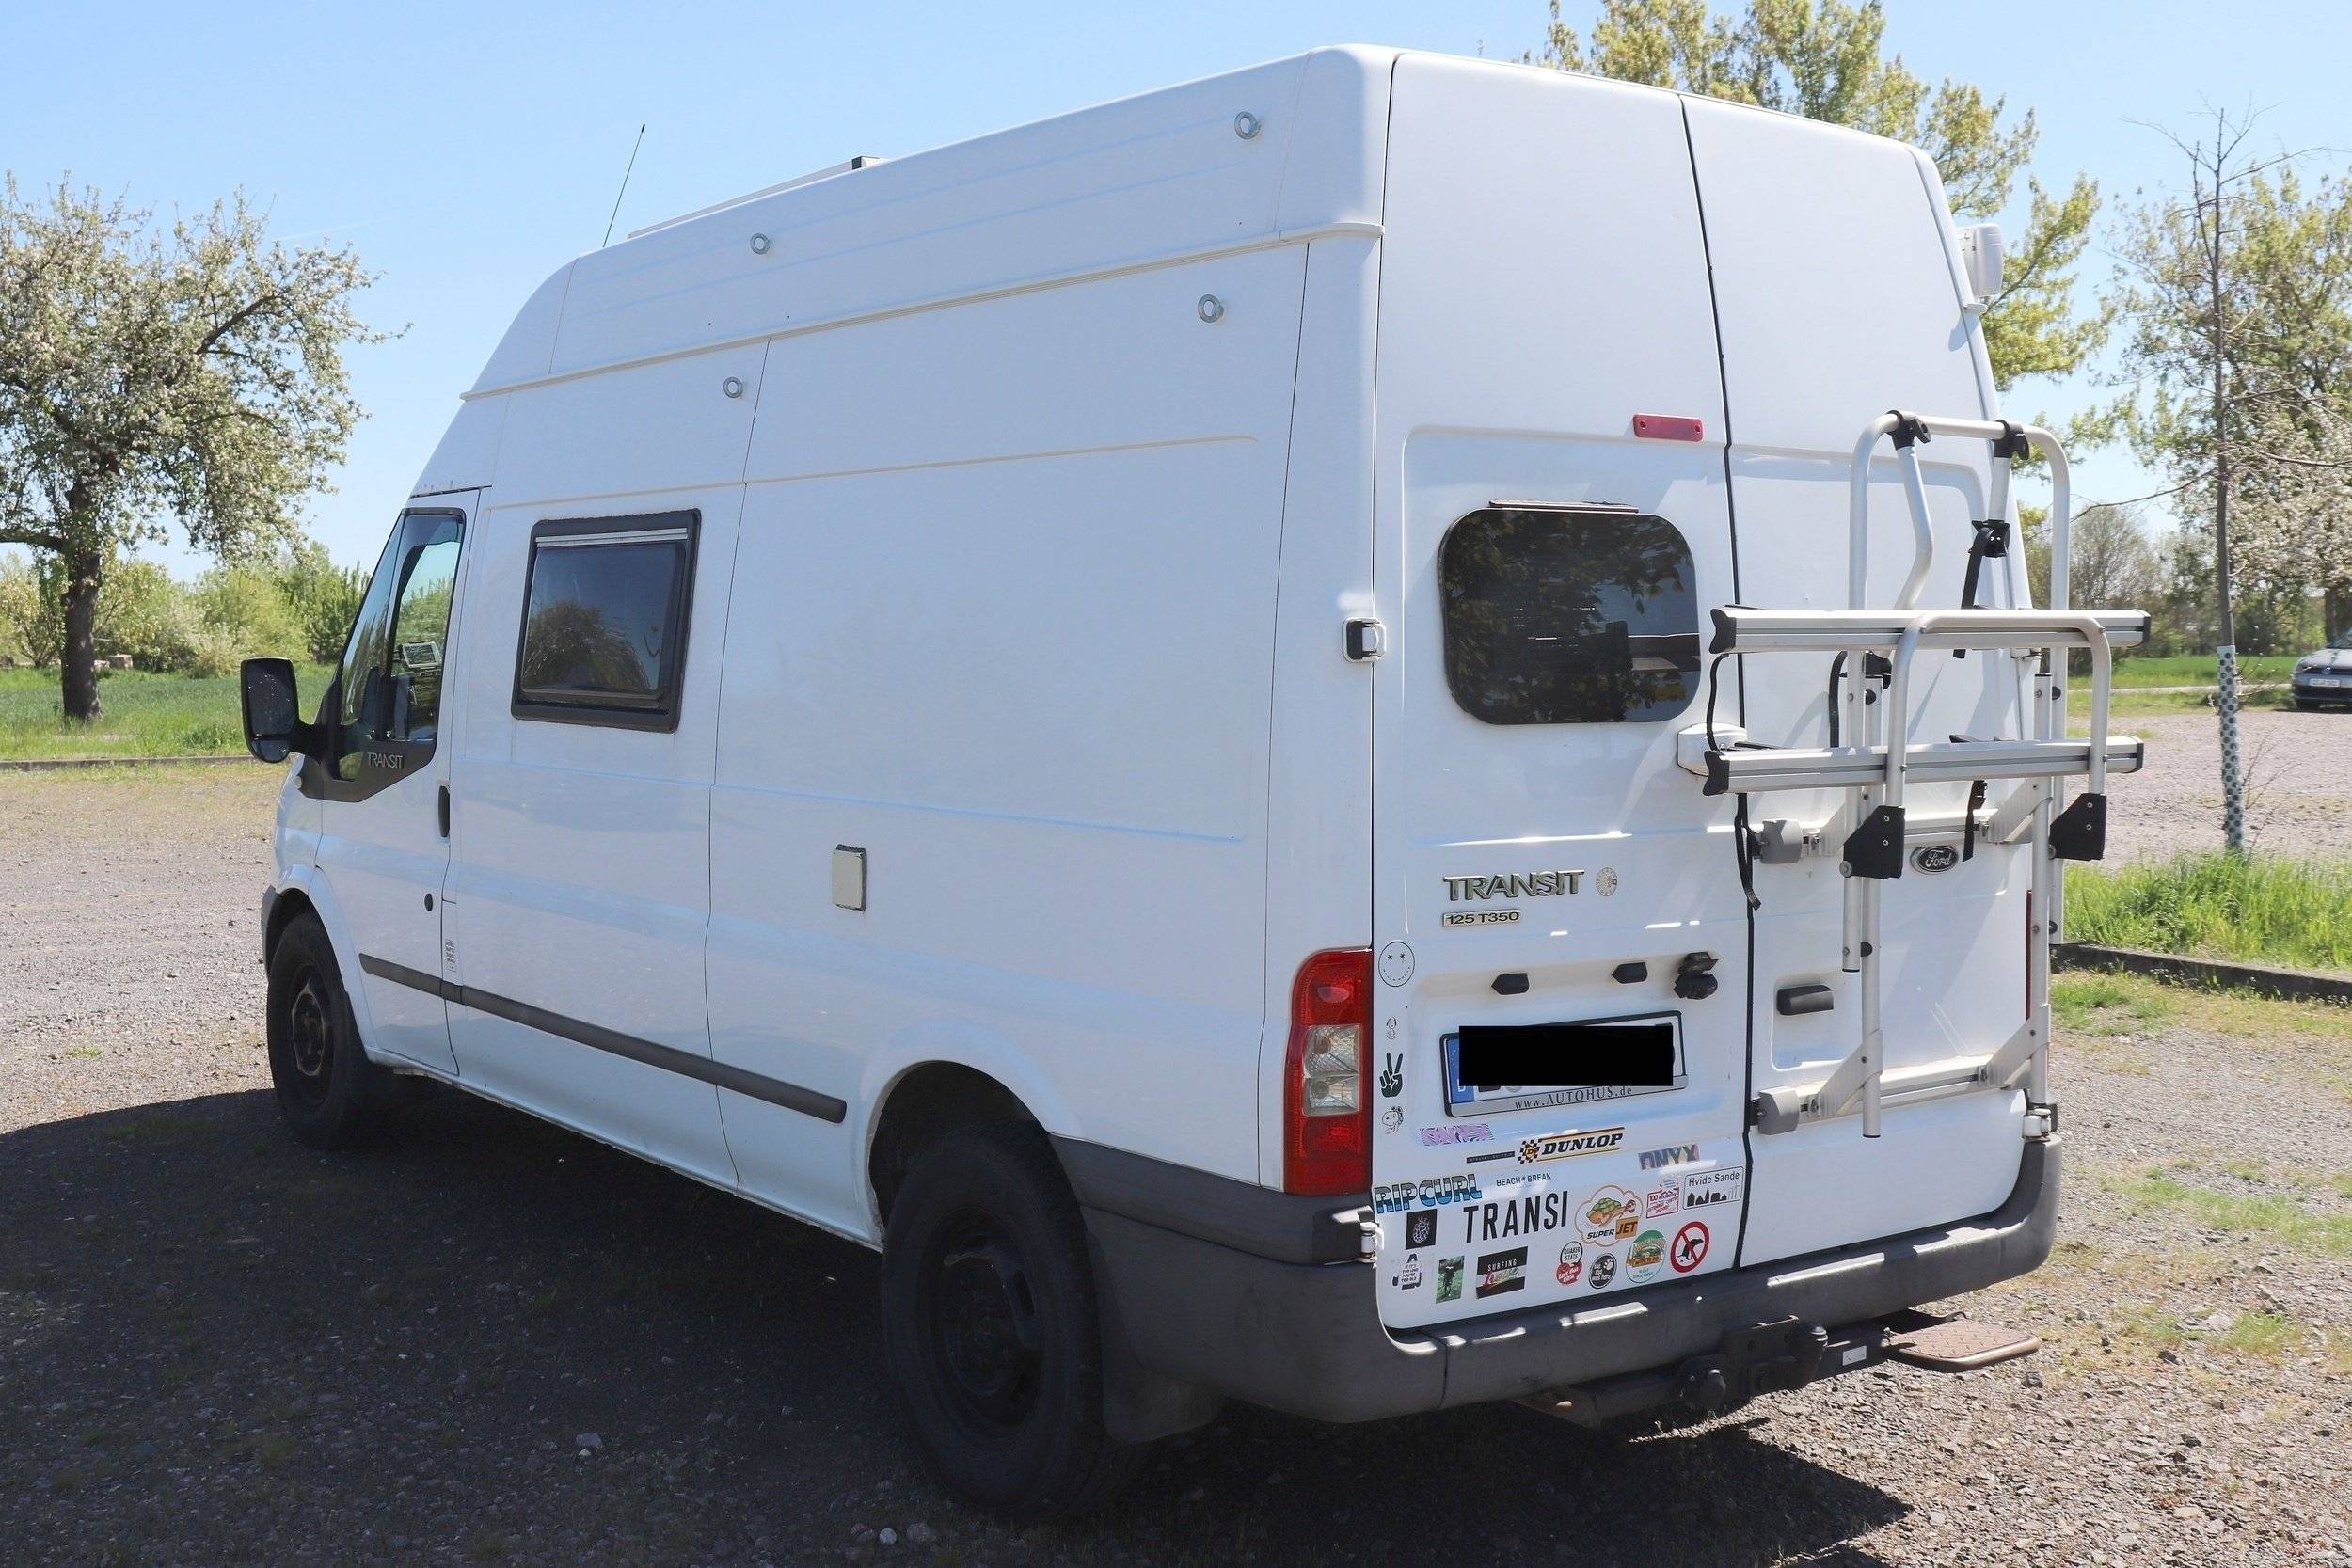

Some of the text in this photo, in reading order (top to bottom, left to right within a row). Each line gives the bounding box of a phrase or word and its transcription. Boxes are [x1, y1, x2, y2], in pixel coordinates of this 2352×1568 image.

[367, 752, 404, 769] TRANSIT
[1925, 849, 1952, 867] Ford
[1442, 869, 1585, 902] TRANSIT
[1446, 911, 1520, 925] 125 T350
[1515, 1085, 1633, 1110] www.AUTOHUS.de
[1541, 1132, 1624, 1156] DUNLOP
[1496, 1172, 1552, 1187] BEACH BREAK
[1689, 1175, 1712, 1187] Hvide
[1714, 1171, 1740, 1183] Sande
[1463, 1191, 1568, 1243] TRANSI
[1587, 1220, 1637, 1240] SUPER JET
[1487, 1259, 1517, 1272] SURFING
